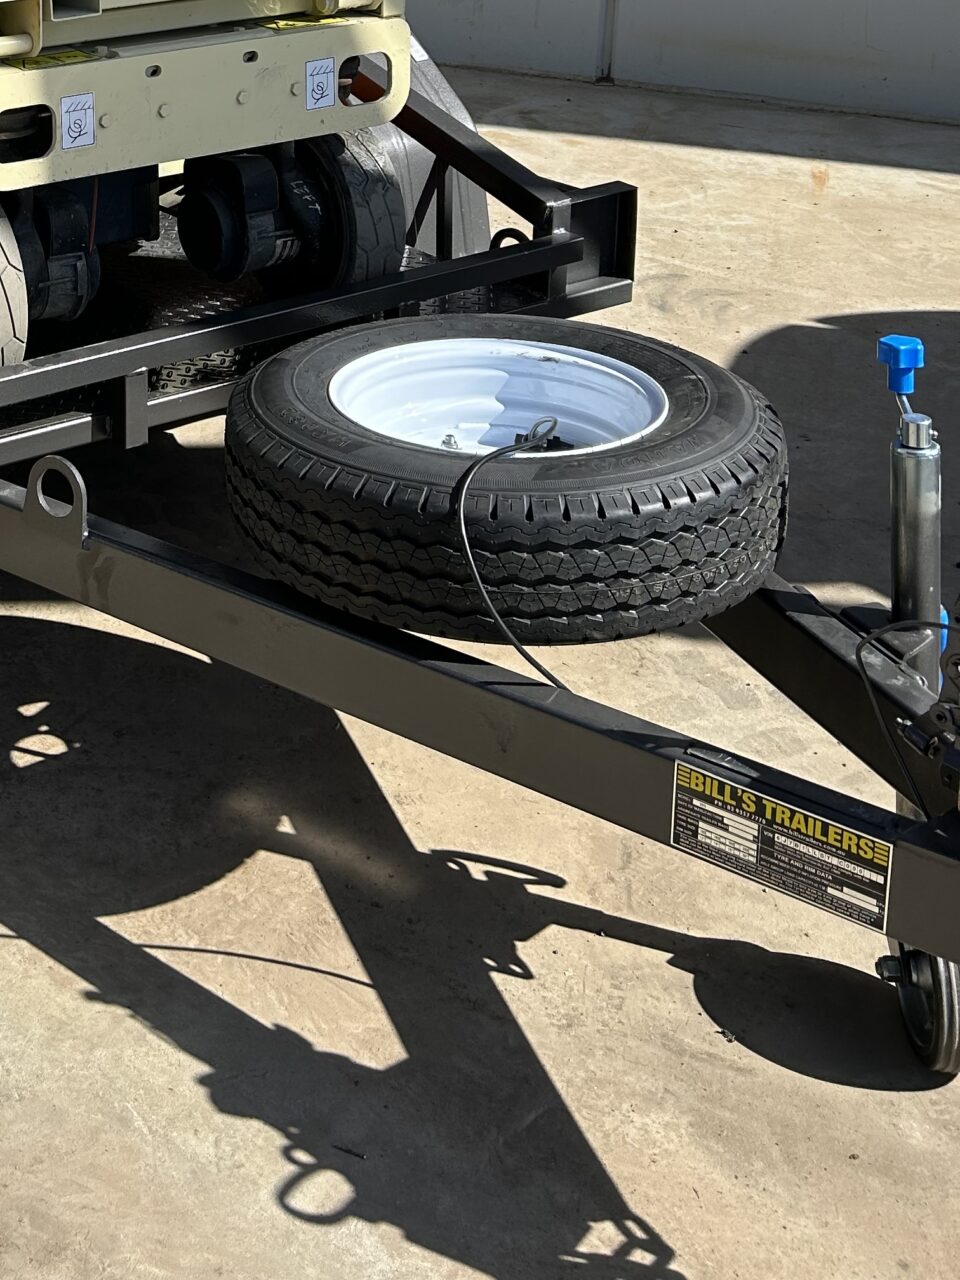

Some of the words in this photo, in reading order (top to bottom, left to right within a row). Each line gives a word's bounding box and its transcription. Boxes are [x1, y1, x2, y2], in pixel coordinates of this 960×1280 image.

[689, 771, 757, 813] BILL'S
[762, 799, 874, 861] TRAILERS
[816, 870, 832, 880] DATA
